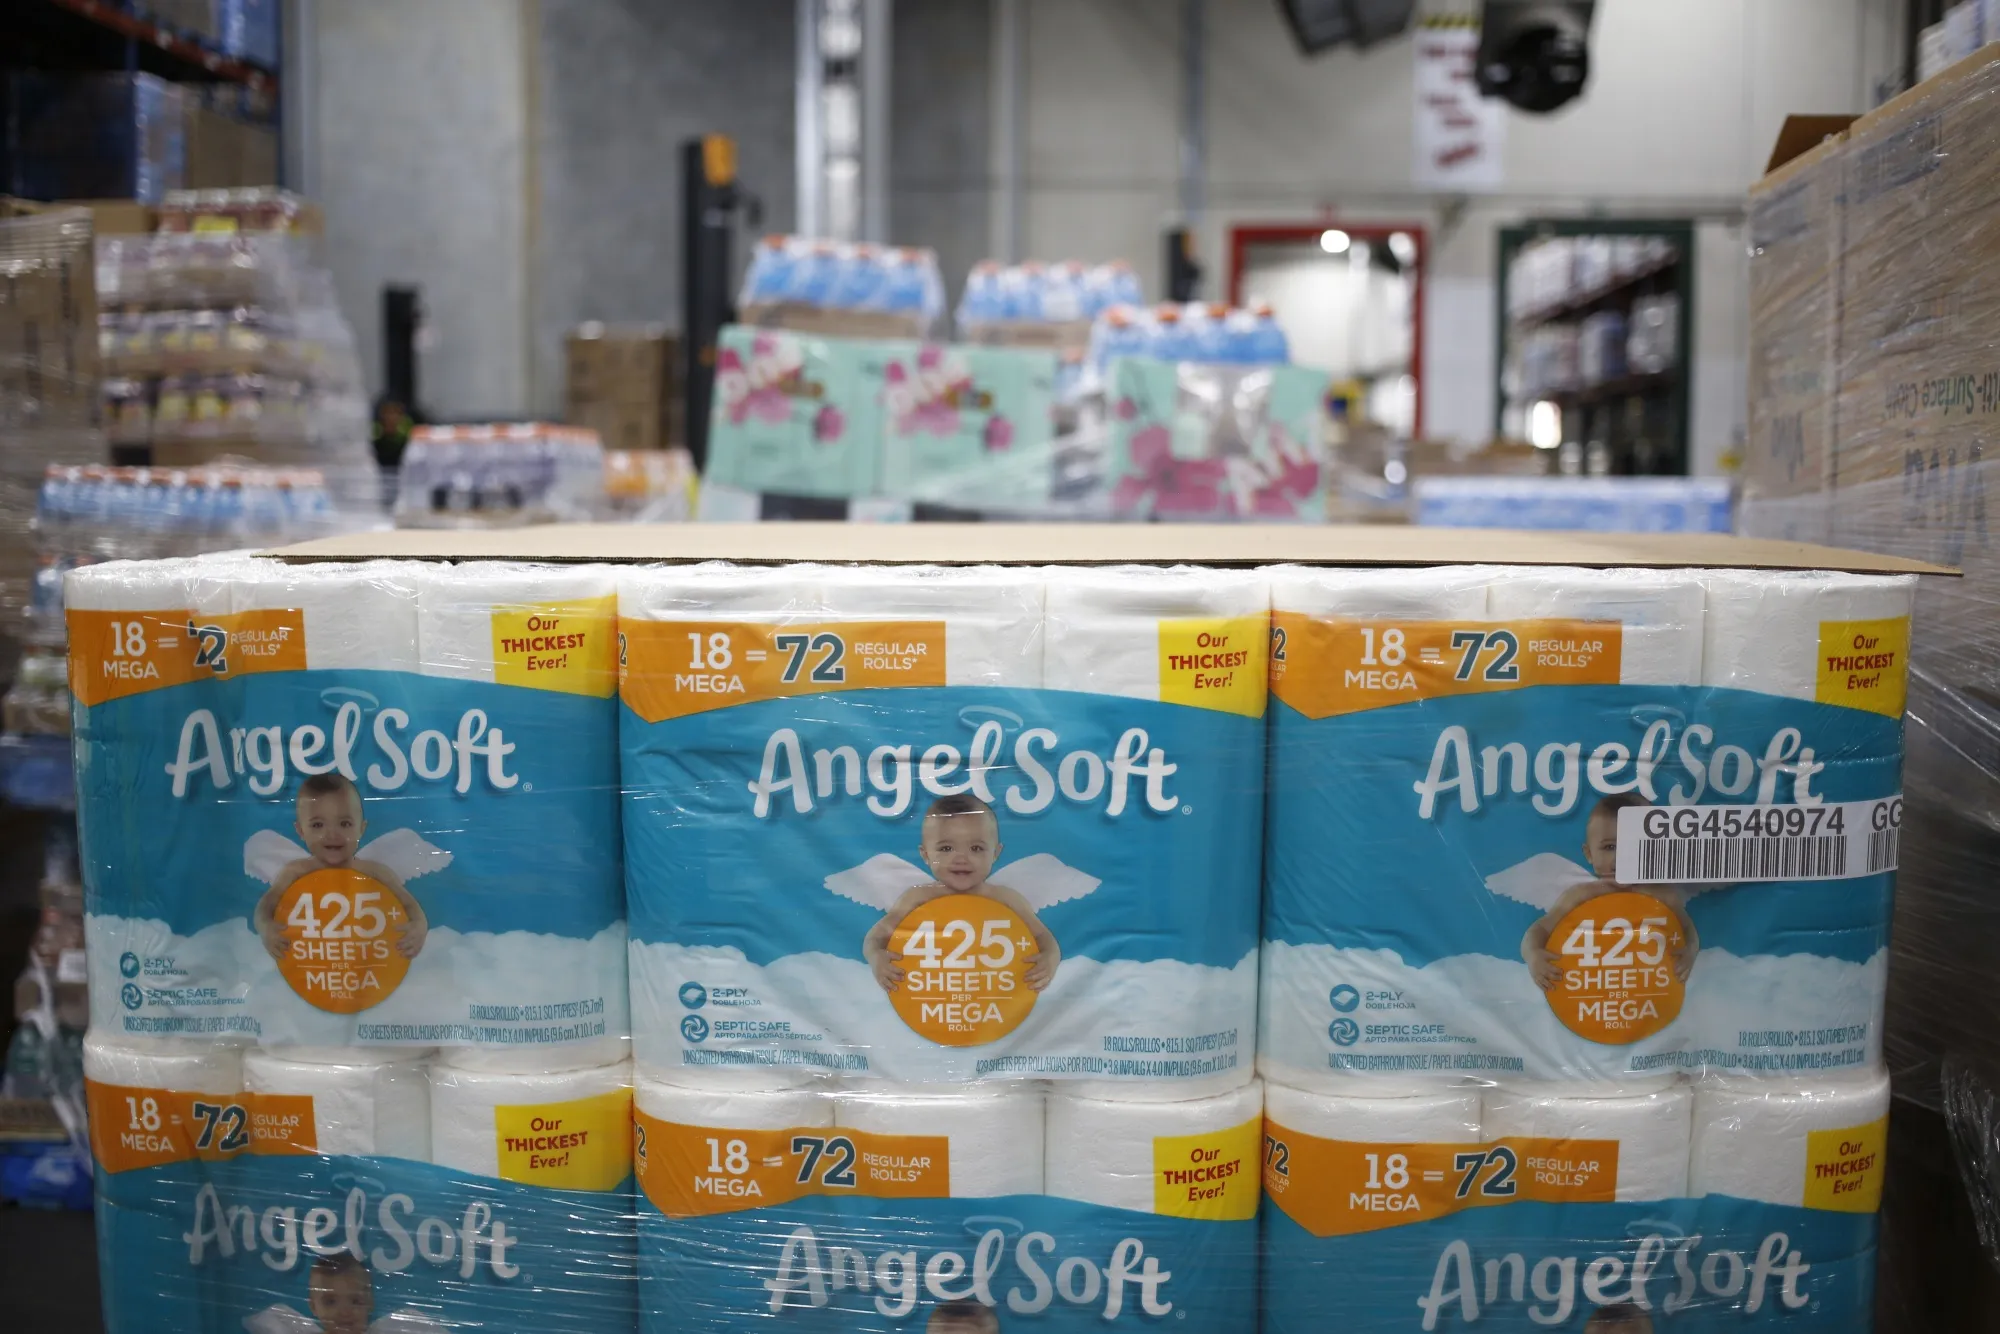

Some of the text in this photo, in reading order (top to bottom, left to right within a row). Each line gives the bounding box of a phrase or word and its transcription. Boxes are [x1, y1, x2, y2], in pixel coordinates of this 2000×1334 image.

[527, 617, 559, 633] Our
[111, 621, 147, 657] 18
[230, 630, 288, 645] REGULAR
[501, 632, 586, 654] THICKEST
[1196, 632, 1228, 650] Our
[1528, 639, 1604, 655] REGULAR
[1852, 634, 1880, 651] Our
[688, 632, 847, 684] 18 72
[854, 642, 927, 658] REGULAR
[1360, 628, 1521, 682] 18 72
[104, 660, 159, 679] MEGA
[526, 654, 568, 671] Ever!
[1168, 650, 1249, 672] THICKEST
[1827, 651, 1895, 673] THICKEST
[674, 673, 745, 694] MEGA
[1193, 672, 1234, 691] Ever!
[1345, 669, 1418, 690] MEGA
[1846, 673, 1881, 691] Ever!
[366, 708, 519, 796] Soft
[748, 720, 1179, 819] Angel Soft
[1413, 719, 1825, 819] Angel Soft
[1643, 806, 1845, 840] GG4540974
[292, 941, 389, 962] SHEETS
[331, 962, 350, 970] PER
[306, 970, 381, 992] MEGA
[906, 971, 1016, 993] SHEETS
[1565, 967, 1670, 991] SHEETS
[186, 988, 217, 999] SAFE
[330, 991, 354, 1000] ROLL
[712, 988, 748, 998] 2-PLY
[951, 994, 972, 1002] PER
[1366, 991, 1404, 1001] 2-PLY
[1608, 991, 1629, 999] PER
[525, 1005, 543, 1021] 815.1
[920, 1003, 1005, 1024] MEGA
[1578, 999, 1659, 1022] MEGA
[714, 1021, 791, 1032] SEPTIC SAFE
[948, 1024, 976, 1033] ROLL
[1365, 1025, 1445, 1035] SEPTIC SAFE
[1604, 1020, 1632, 1029] ROLL
[785, 1032, 823, 1041] SÉPTICAS
[1103, 1035, 1112, 1051] 18
[1112, 1036, 1160, 1053] ROLLS/ROLLOS
[1166, 1037, 1184, 1053] 815.1
[1438, 1035, 1477, 1043] SÉPTICAS
[1739, 1031, 1747, 1047] 18
[1799, 1030, 1816, 1047] 815.1
[682, 1049, 720, 1065] UNSCENTED
[720, 1050, 756, 1065] BATHROOM
[756, 1050, 778, 1065] TISSUE
[782, 1050, 802, 1065] PAPEL
[834, 1054, 845, 1069] SIN
[845, 1054, 869, 1070] AROMA
[989, 1056, 1014, 1072] SHEETS
[1014, 1056, 1028, 1072] PER
[1067, 1057, 1081, 1073] POR
[1081, 1057, 1103, 1073] ROLLO
[1108, 1059, 1118, 1075] 3.8
[1146, 1061, 1152, 1076] X
[1152, 1061, 1163, 1076] 4.0
[1328, 1053, 1368, 1070] UNSCENTED
[1368, 1053, 1405, 1071] BATHROOM
[1405, 1053, 1429, 1070] TISSUE
[1432, 1054, 1452, 1070] PAPEL
[1487, 1055, 1499, 1071] SIN
[1500, 1056, 1524, 1072] AROMA
[126, 1096, 249, 1152] 18 72
[530, 1117, 562, 1132] Our
[120, 1132, 175, 1153] MEGA
[505, 1131, 588, 1152] THICKEST
[1838, 1139, 1863, 1157] Our
[528, 1150, 569, 1169] Ever!
[705, 1134, 858, 1189] 18 72
[863, 1152, 931, 1170] REGULAR
[1189, 1147, 1220, 1164] Our
[1266, 1133, 1290, 1178] 72
[1526, 1156, 1600, 1173] REGULAR
[1814, 1154, 1876, 1177] THICKEST
[1164, 1161, 1241, 1186] THICKEST
[1363, 1146, 1519, 1199] 18 72
[694, 1176, 762, 1198] MEGA
[1187, 1181, 1226, 1203] Ever!
[1832, 1175, 1864, 1196] Ever!
[1349, 1191, 1421, 1212] MEGA
[183, 1183, 520, 1281] Angel Soft
[764, 1226, 1173, 1321] Angel Soft
[1417, 1231, 1811, 1331] Angel Soft
